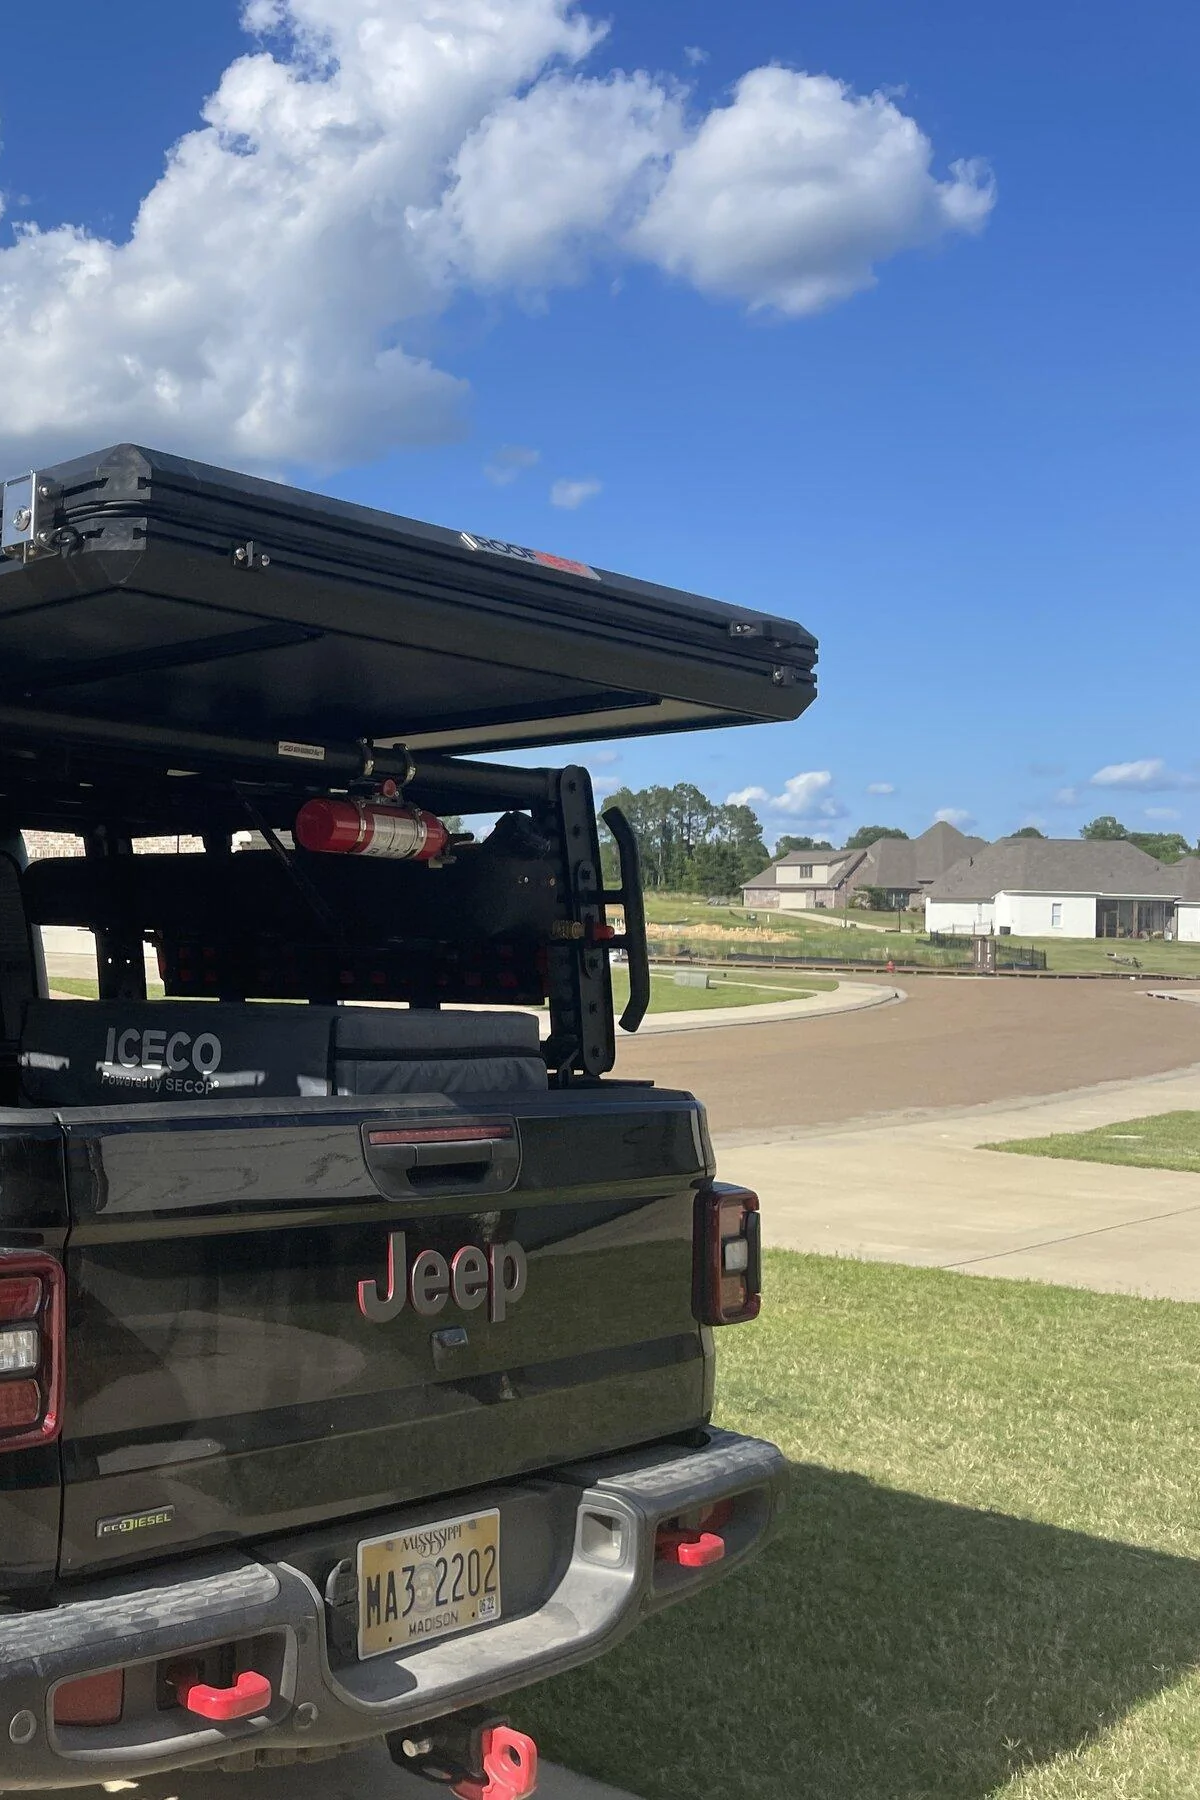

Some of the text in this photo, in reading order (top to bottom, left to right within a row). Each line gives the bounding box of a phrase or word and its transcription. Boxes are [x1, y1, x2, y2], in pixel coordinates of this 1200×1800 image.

[104, 1027, 222, 1075] ICECO
[101, 1072, 214, 1095] Powered by SECOP
[358, 1231, 527, 1324] Jeep
[366, 1545, 497, 1629] MA3 2202
[408, 1611, 459, 1637] MADISON
